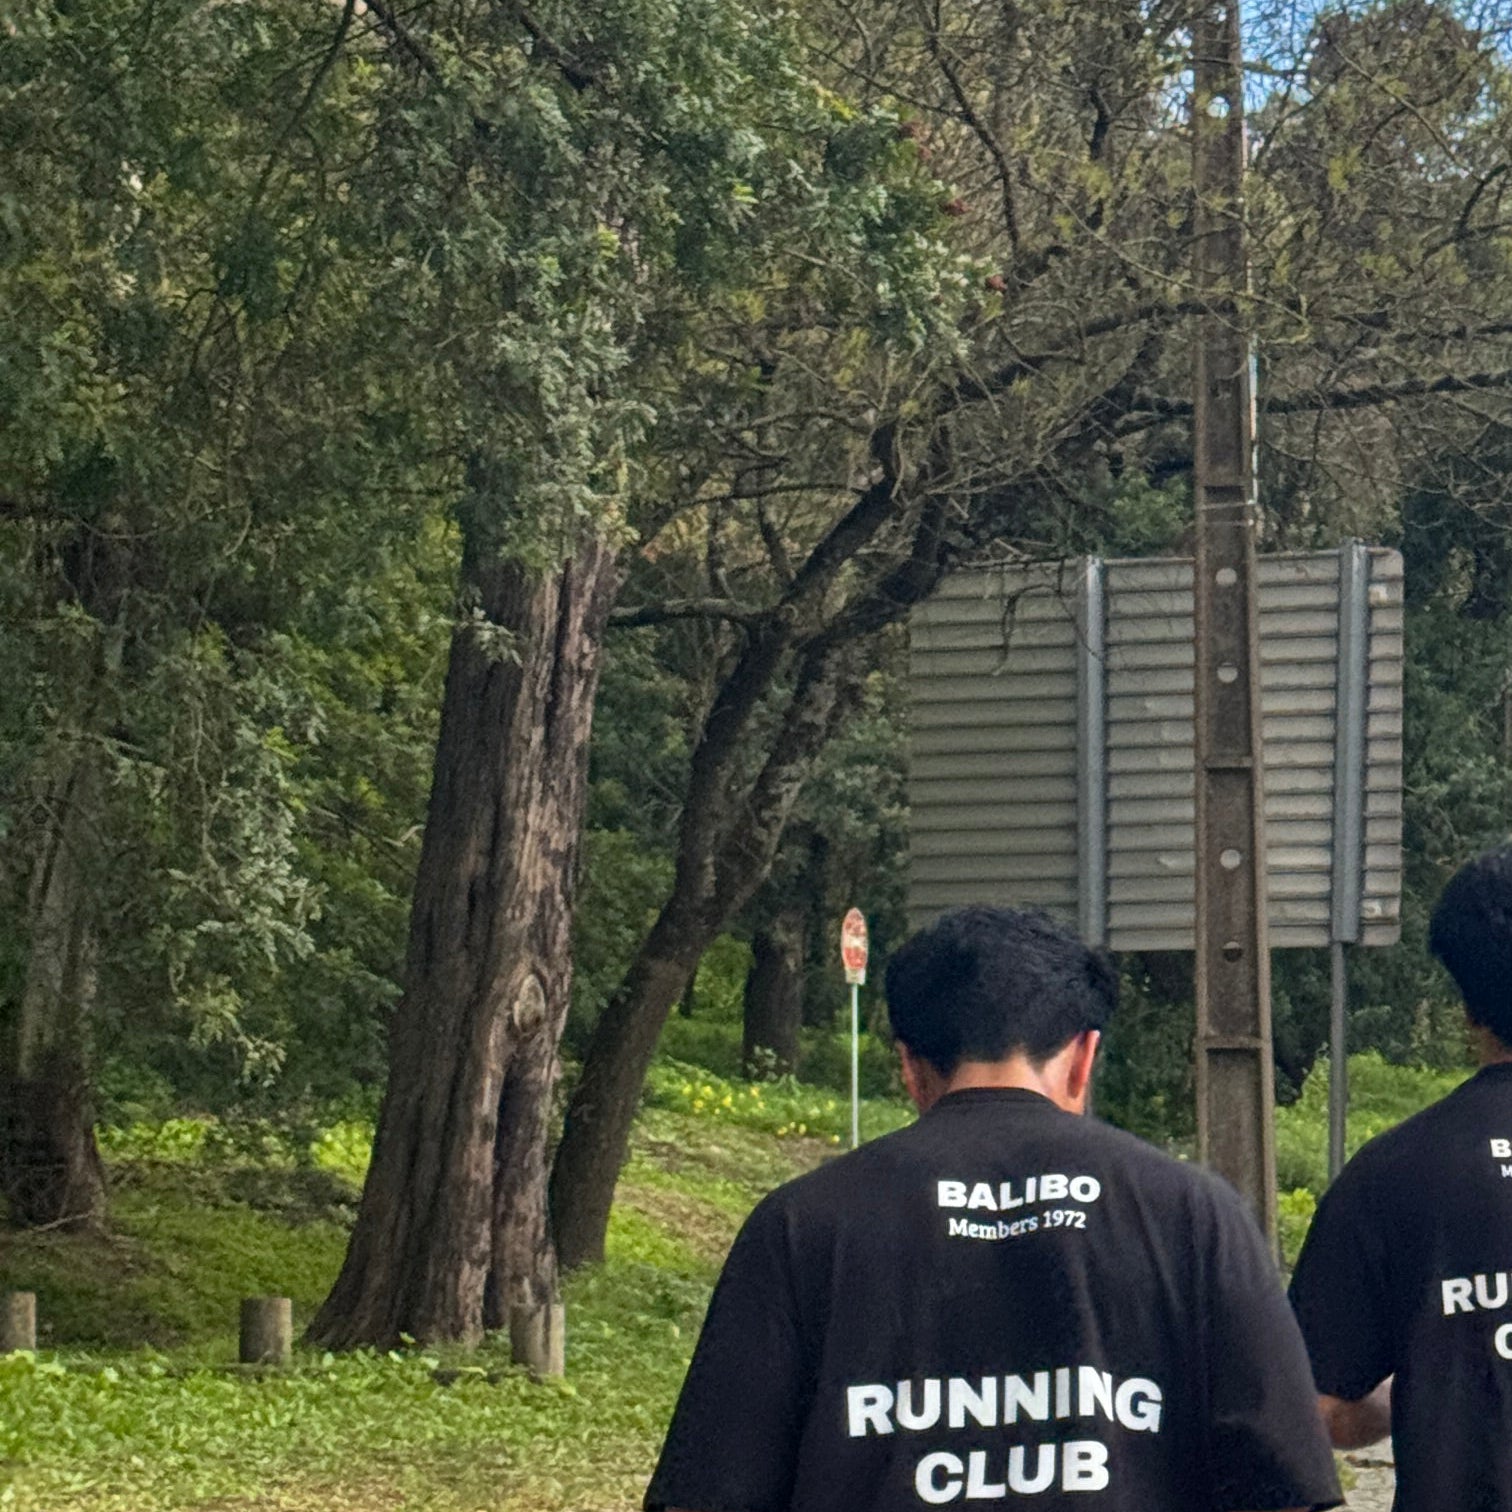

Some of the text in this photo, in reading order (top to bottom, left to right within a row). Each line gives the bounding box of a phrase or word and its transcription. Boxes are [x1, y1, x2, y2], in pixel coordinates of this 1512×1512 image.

[937, 1174, 1102, 1212] BALIBO
[948, 1210, 1087, 1240] Members 1972
[846, 1365, 1164, 1439] RUNNING
[914, 1439, 1111, 1505] CLUB
